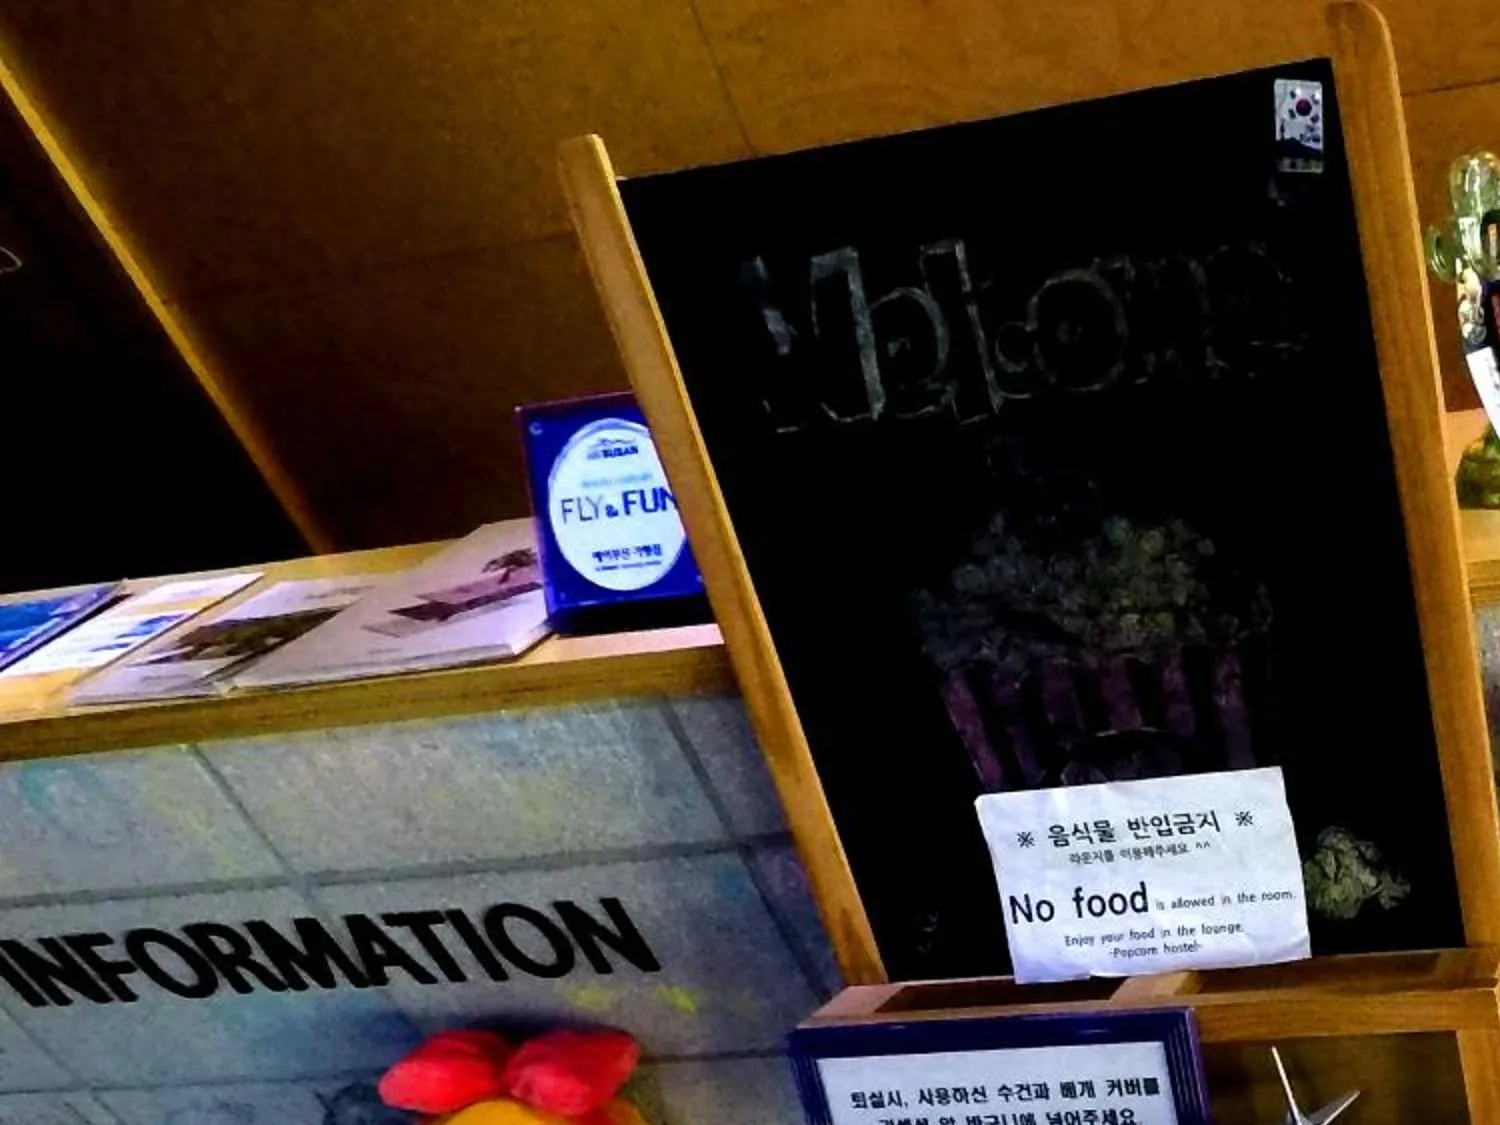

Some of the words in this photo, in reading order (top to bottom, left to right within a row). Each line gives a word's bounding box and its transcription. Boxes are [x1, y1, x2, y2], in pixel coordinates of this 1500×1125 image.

[561, 494, 603, 524] FLY
[605, 504, 619, 518] &
[1048, 819, 1117, 847] 음식물
[1128, 810, 1221, 840] 반입금지
[1010, 893, 1055, 925] No
[1073, 881, 1149, 919] food
[1156, 899, 1165, 911] is
[1172, 895, 1215, 910] allowed
[1222, 894, 1232, 906] in
[1238, 891, 1256, 904] the
[1261, 890, 1297, 901] room.
[1064, 932, 1095, 948] Enjoy
[1101, 932, 1125, 945] your
[1130, 927, 1155, 940] food
[1161, 927, 1171, 938] in
[1177, 924, 1196, 937] the
[1201, 921, 1245, 938] lounge.
[0, 898, 661, 1008] INFORMATION
[918, 1084, 987, 1106] 사용하신
[997, 1082, 1050, 1102] 수건과
[1106, 1077, 1160, 1096] 커버를
